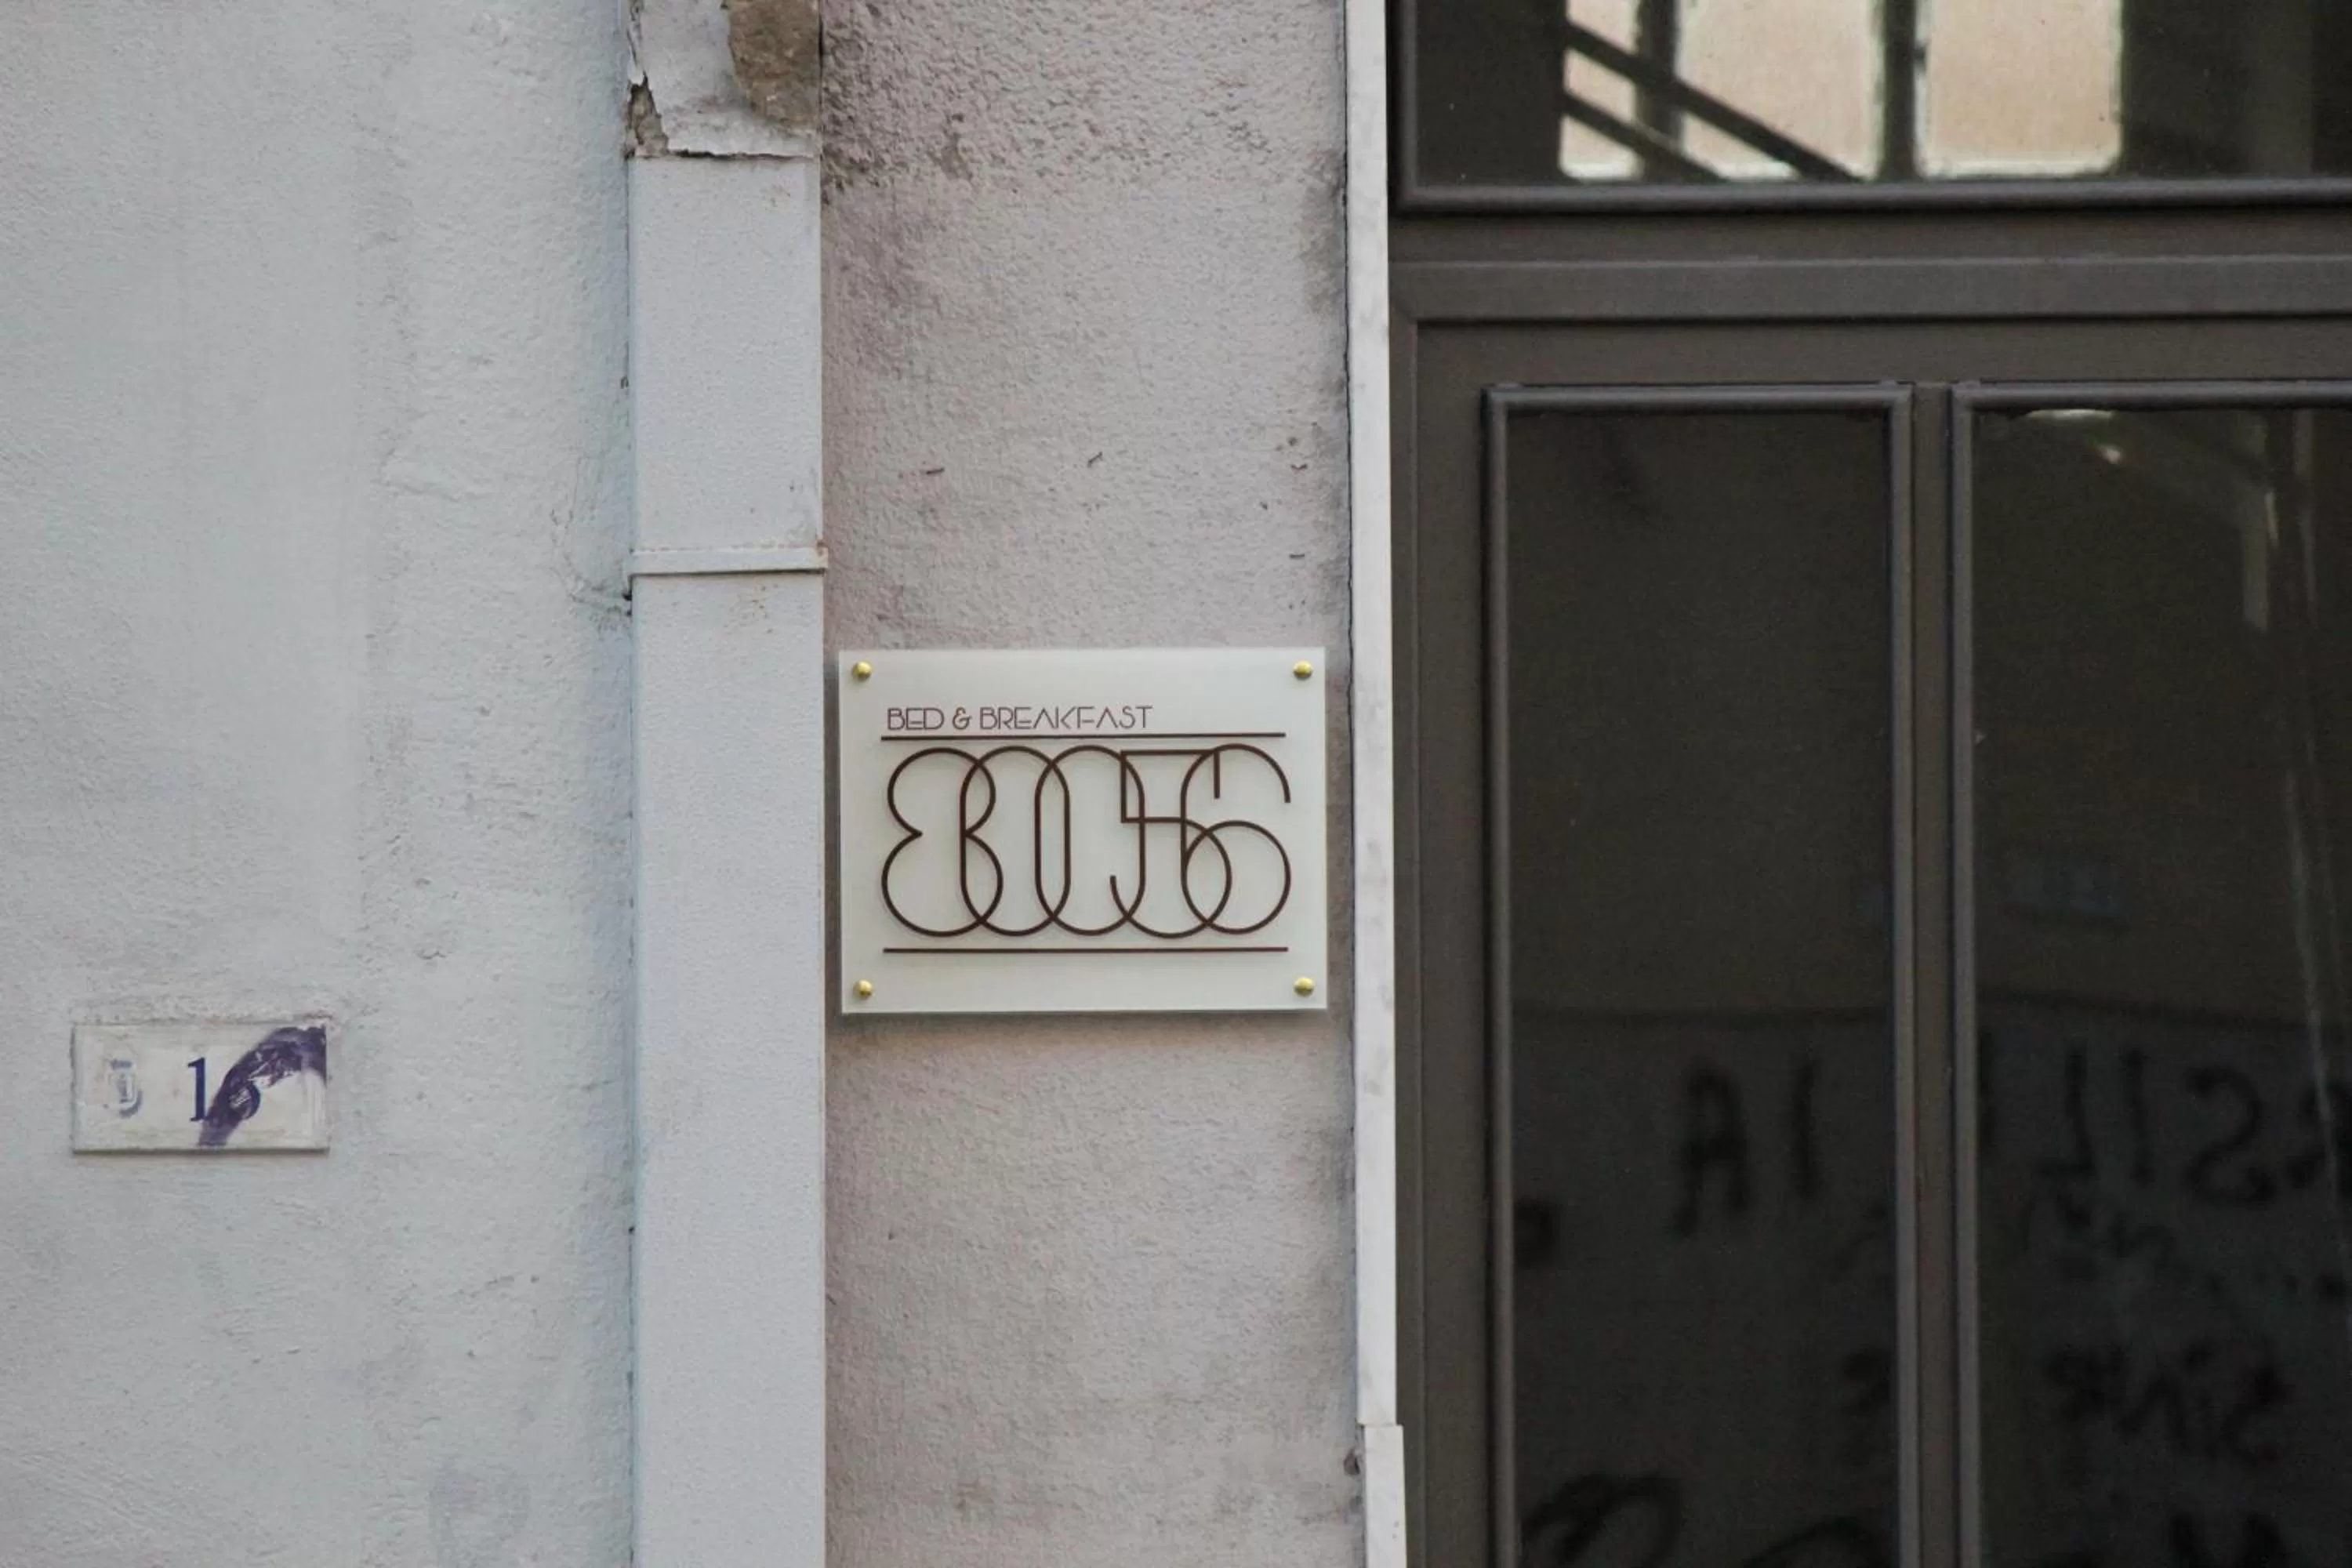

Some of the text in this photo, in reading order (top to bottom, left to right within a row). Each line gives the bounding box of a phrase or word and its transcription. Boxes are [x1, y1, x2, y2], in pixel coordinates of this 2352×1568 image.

[887, 705, 1153, 731] BED & BREAKFAST
